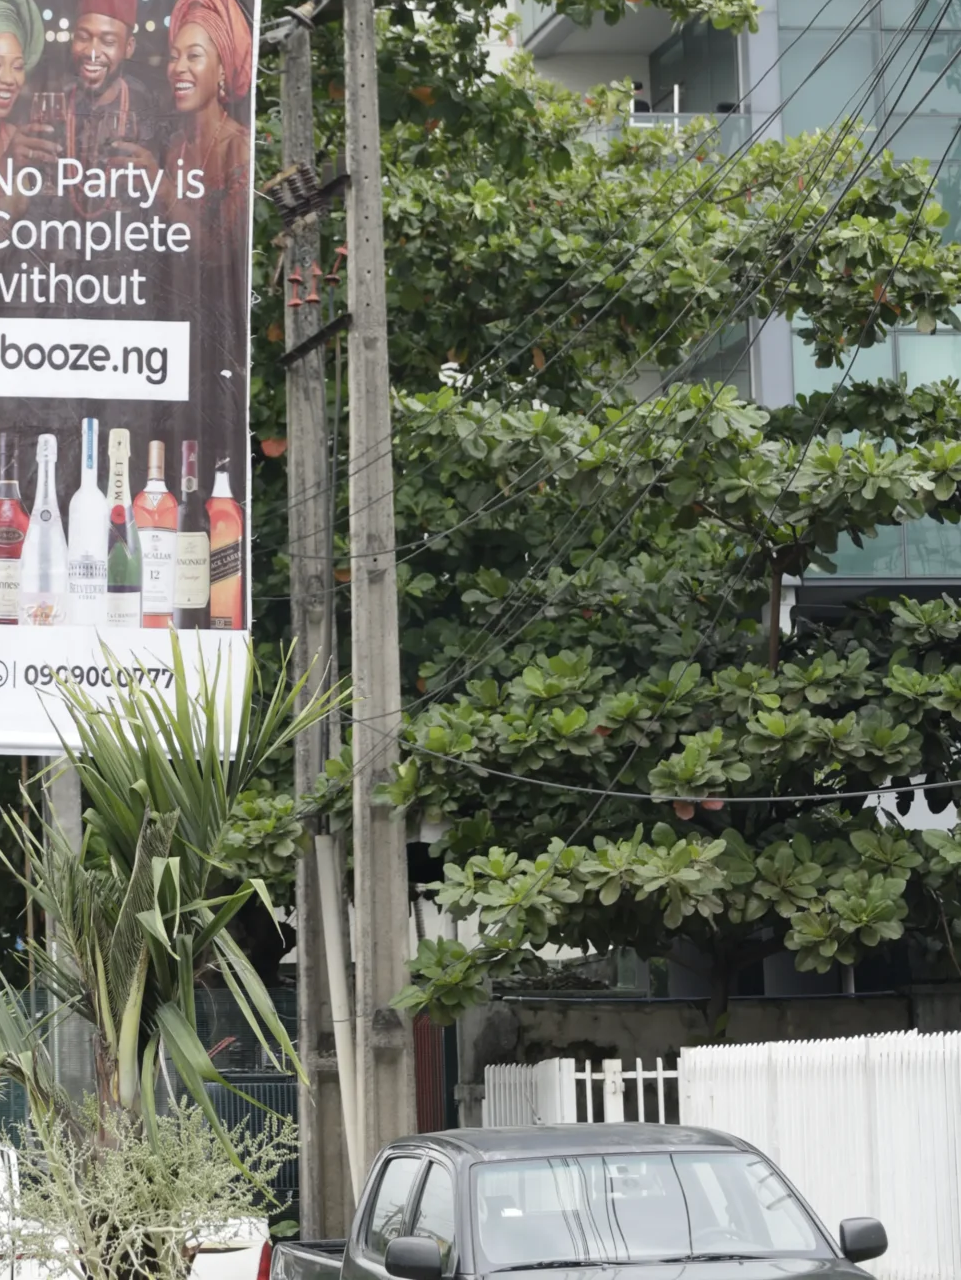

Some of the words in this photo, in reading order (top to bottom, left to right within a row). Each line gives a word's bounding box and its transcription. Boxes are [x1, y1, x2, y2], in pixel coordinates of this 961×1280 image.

[57, 158, 164, 208] Party
[176, 159, 205, 199] is
[0, 333, 168, 385] booze.ng
